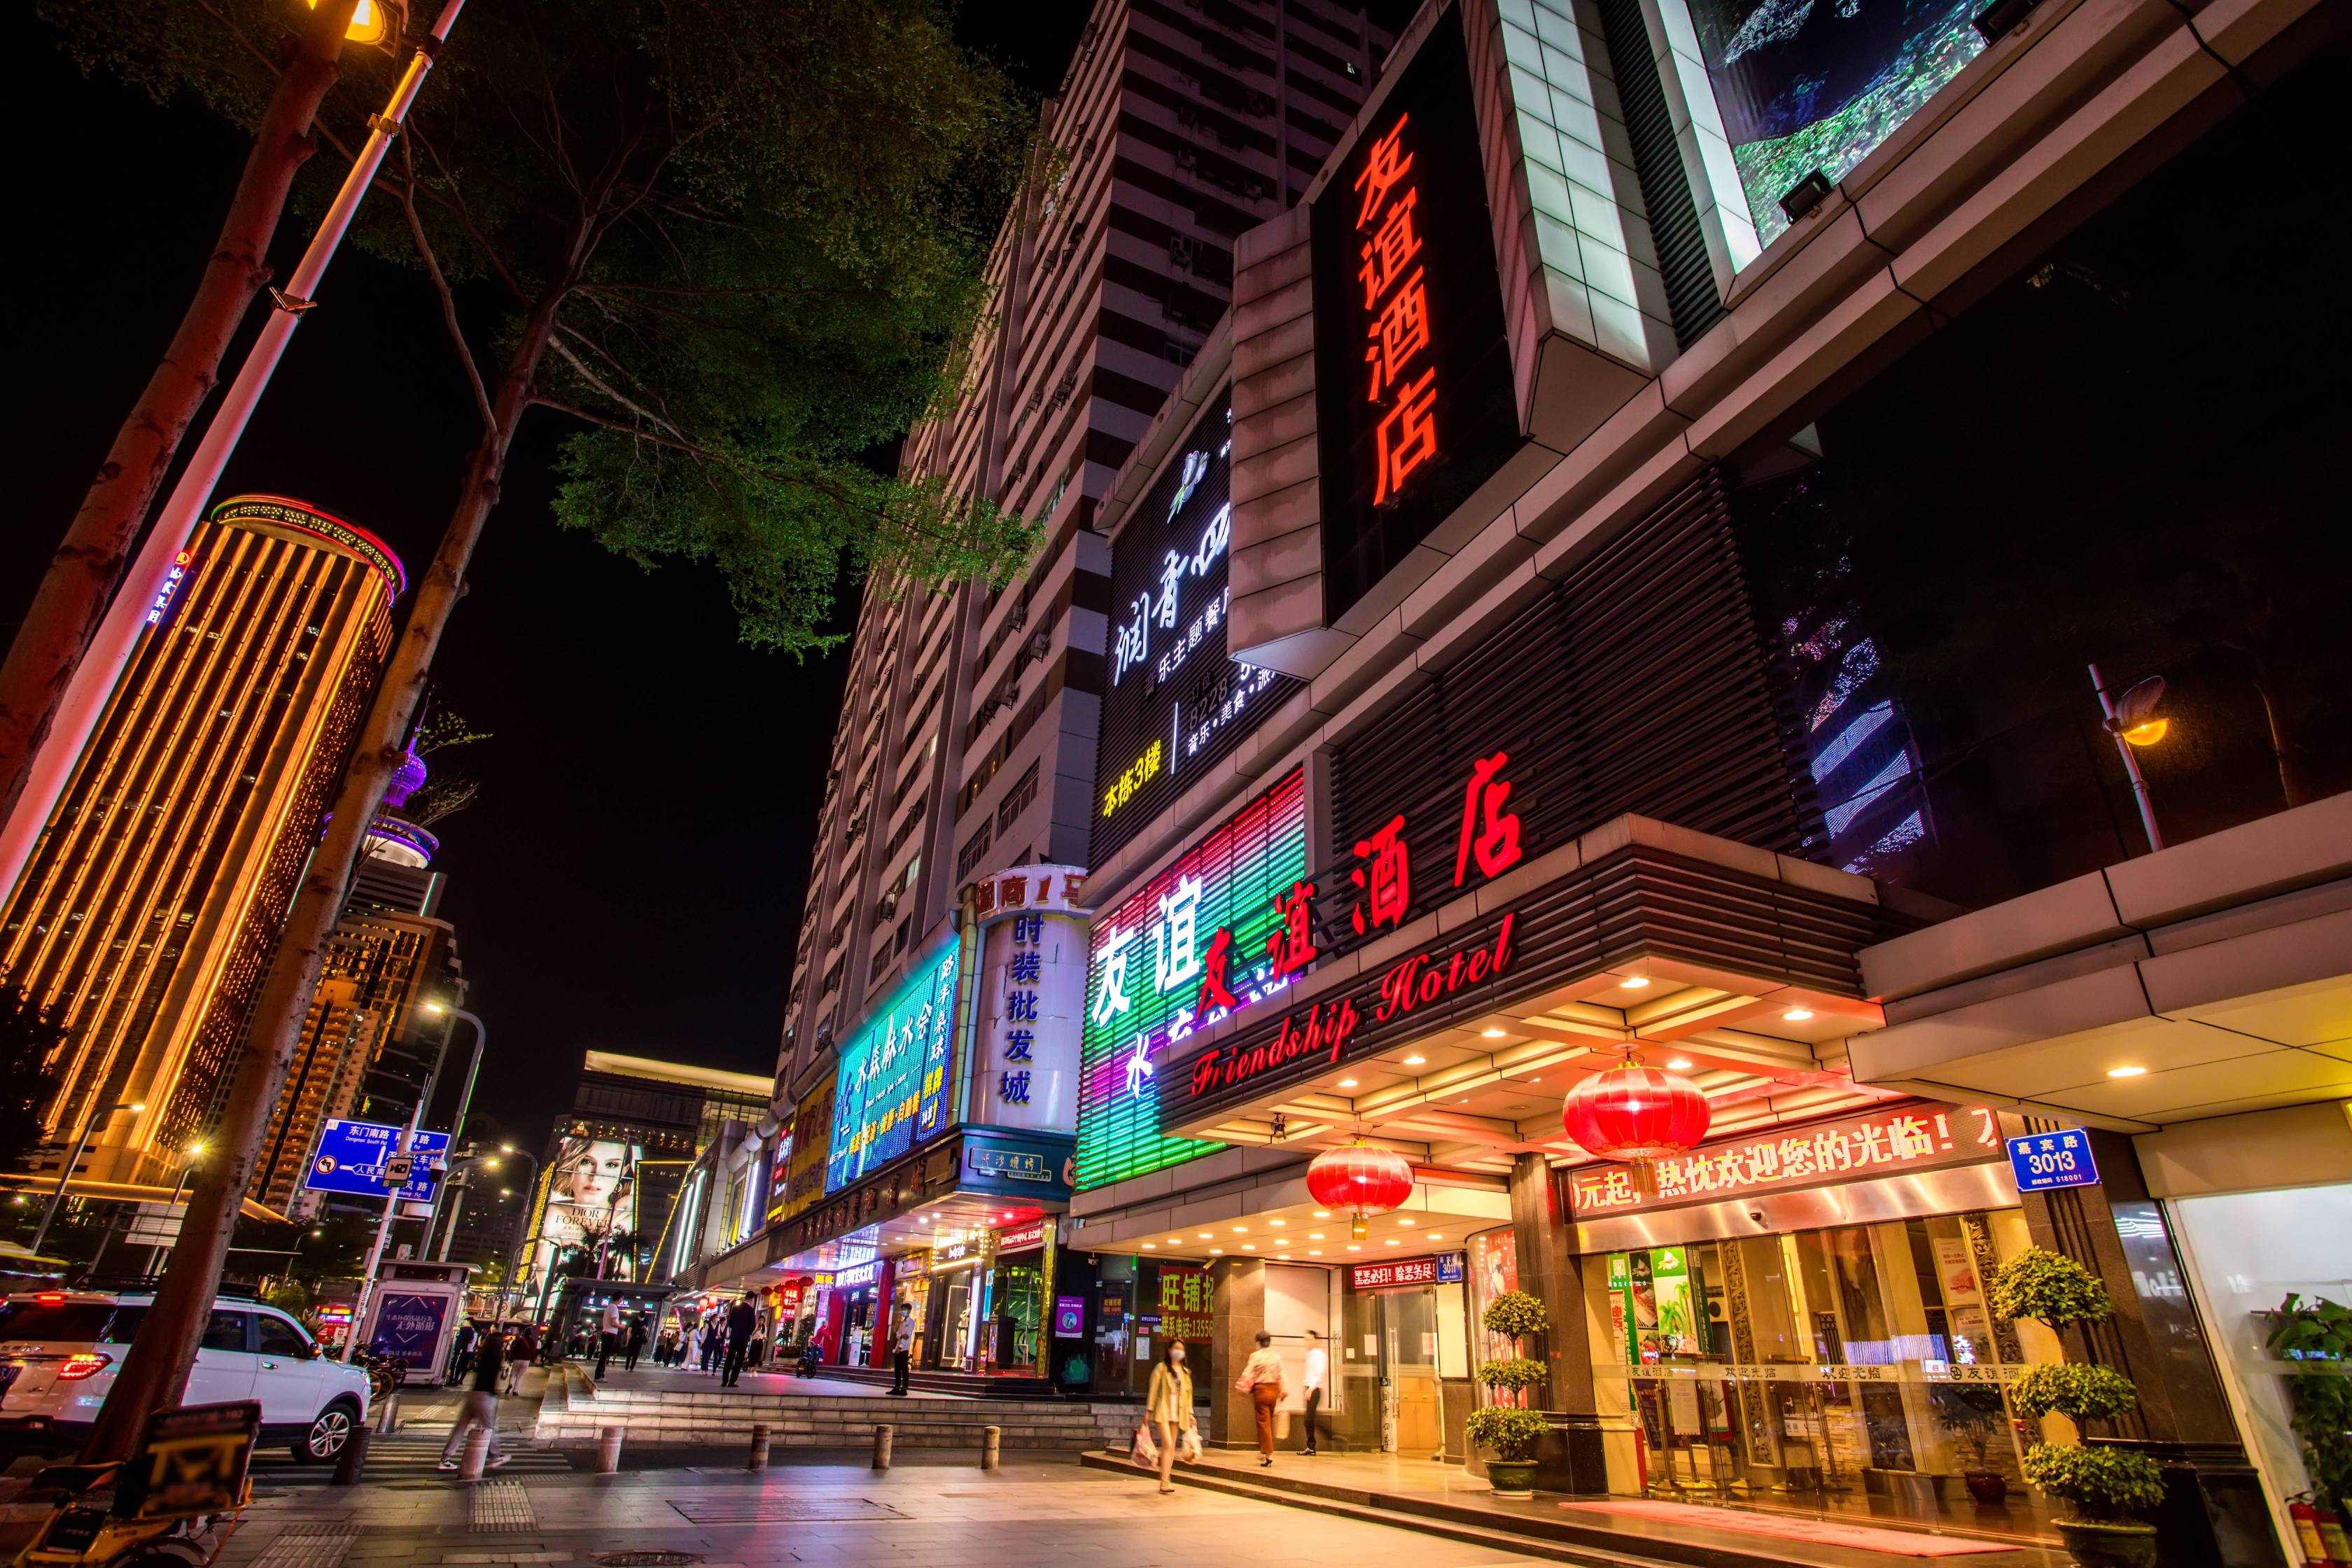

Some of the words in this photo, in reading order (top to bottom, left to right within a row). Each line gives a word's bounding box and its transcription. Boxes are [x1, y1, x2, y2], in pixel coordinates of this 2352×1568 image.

[1354, 111, 1436, 507] 友谊酒店
[1143, 587, 1230, 699] 音乐主题餐
[1103, 739, 1161, 817] 本栋3楼
[1196, 751, 1527, 1019] 友谊酒店
[1091, 874, 1202, 1028] 友谊
[1000, 913, 1045, 1104] 时装批发城
[1191, 1000, 1360, 1096] Friendship
[1376, 913, 1517, 1022] Hotel
[349, 1126, 390, 1139] 东门南路
[2017, 1135, 2078, 1155] 嘉宾路
[356, 1164, 386, 1176] 人民南
[2029, 1150, 2076, 1175] 3013
[2056, 1174, 2082, 1183] 518001
[572, 1208, 599, 1218] DIOR
[1726, 1366, 1777, 1379] 欢迎光临
